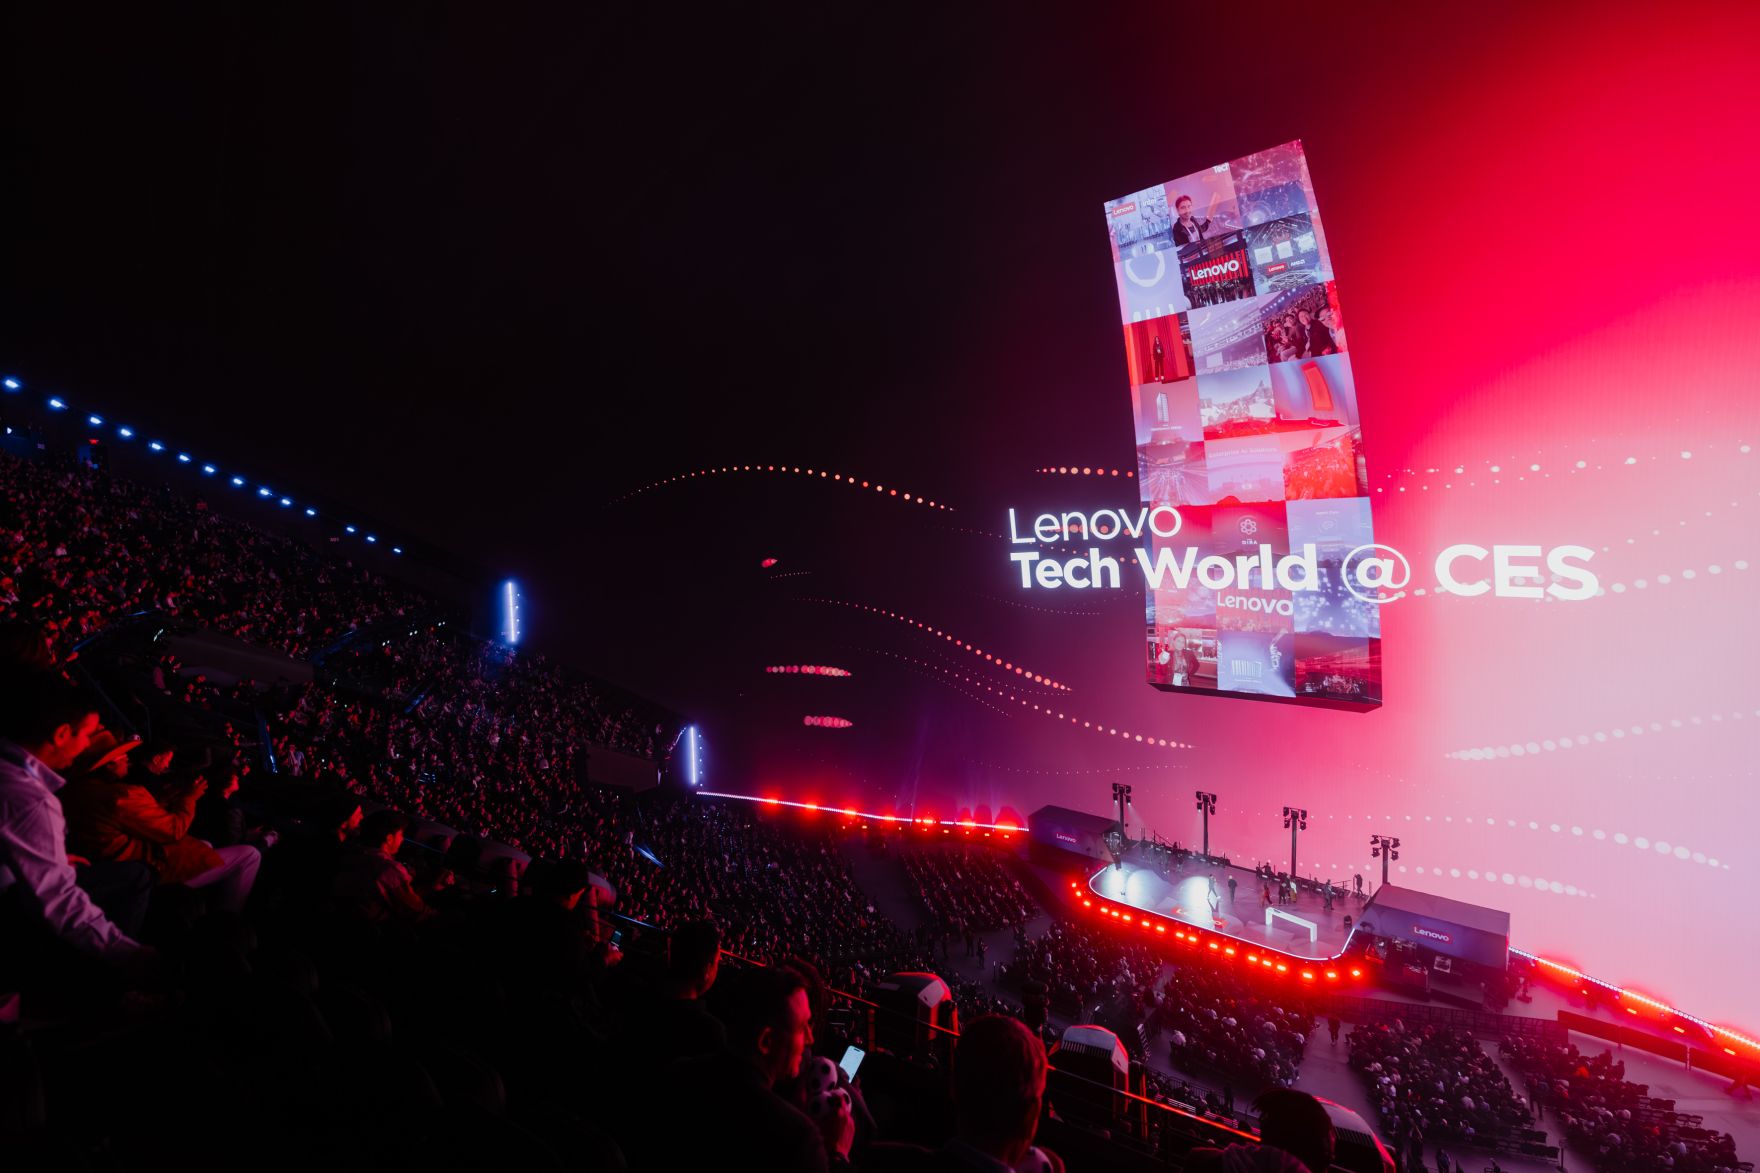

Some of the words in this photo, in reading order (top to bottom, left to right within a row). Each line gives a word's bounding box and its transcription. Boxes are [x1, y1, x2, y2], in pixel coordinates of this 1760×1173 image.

[1113, 205, 1134, 215] Lenovo
[1191, 259, 1239, 281] Lenovo
[1008, 505, 1182, 544] Lenovo
[1010, 547, 1121, 589] Tech
[1134, 543, 1319, 591] World
[1341, 543, 1411, 604] @
[1434, 543, 1600, 601] CES
[1217, 591, 1294, 616] Lenovo
[1056, 833, 1076, 843] Lenovo
[1414, 926, 1450, 942] Lenovo
